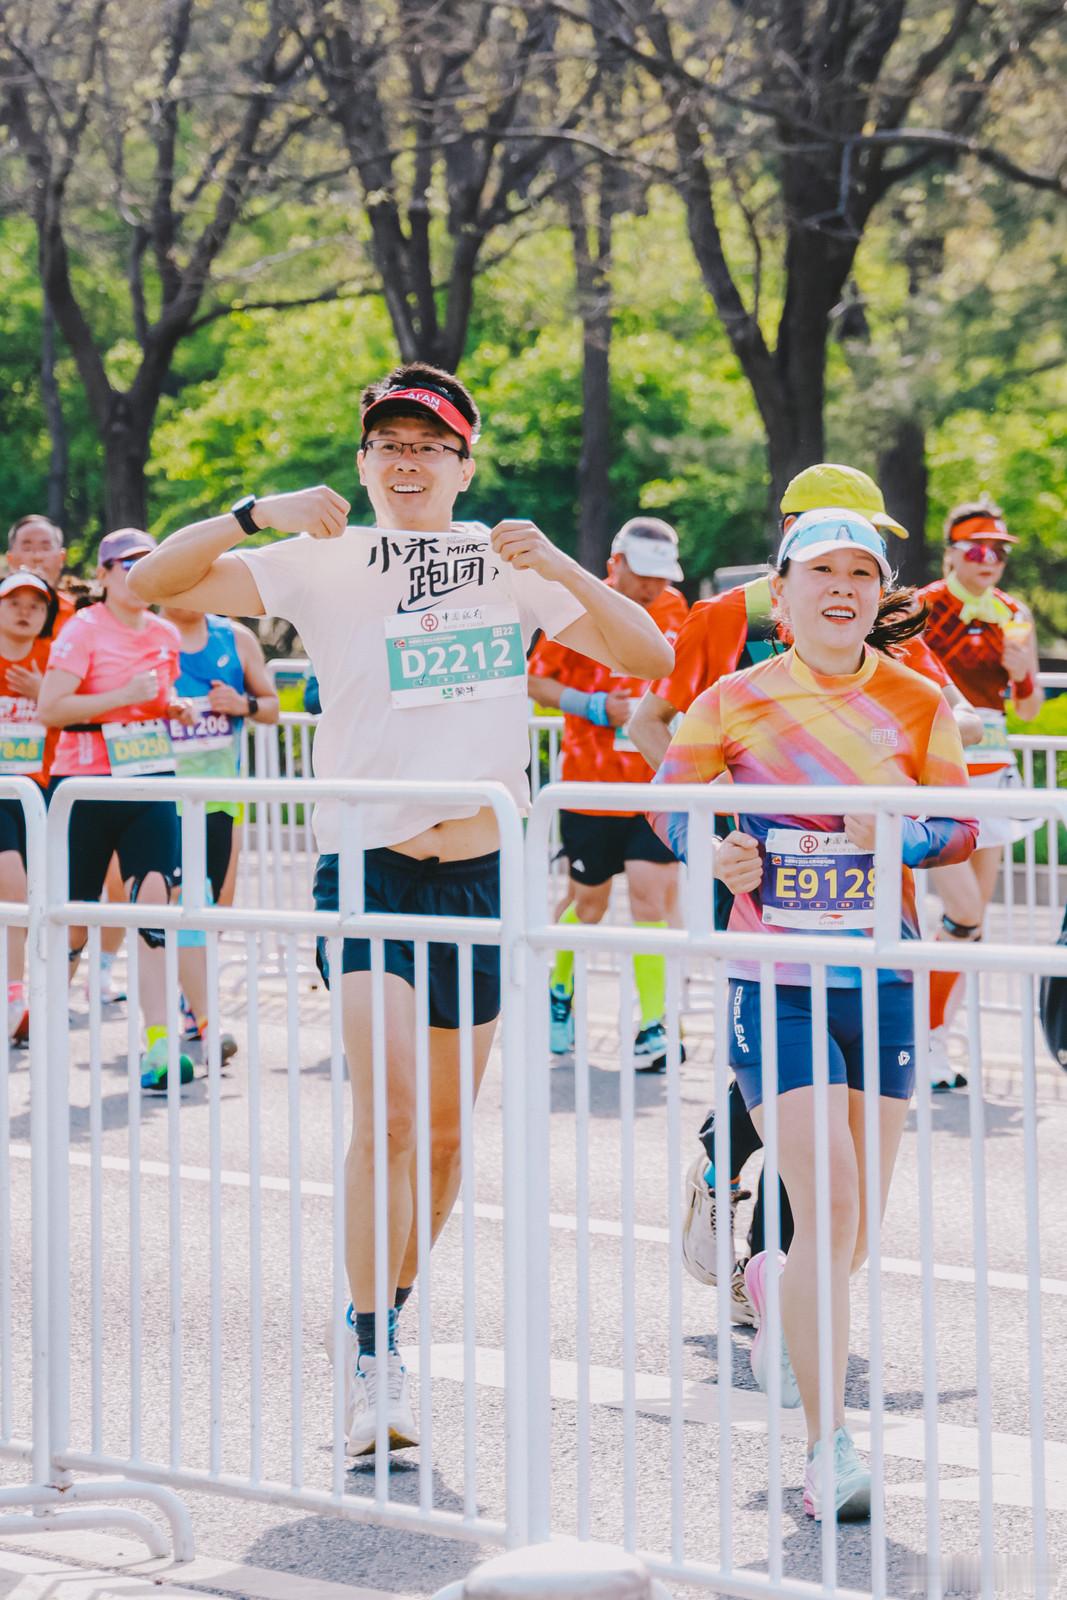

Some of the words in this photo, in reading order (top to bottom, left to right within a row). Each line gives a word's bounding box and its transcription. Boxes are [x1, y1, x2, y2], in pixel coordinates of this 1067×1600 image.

[367, 536, 441, 574] 小米
[446, 543, 489, 557] MiRC
[407, 556, 485, 606] 跑团
[401, 638, 513, 679] D2212
